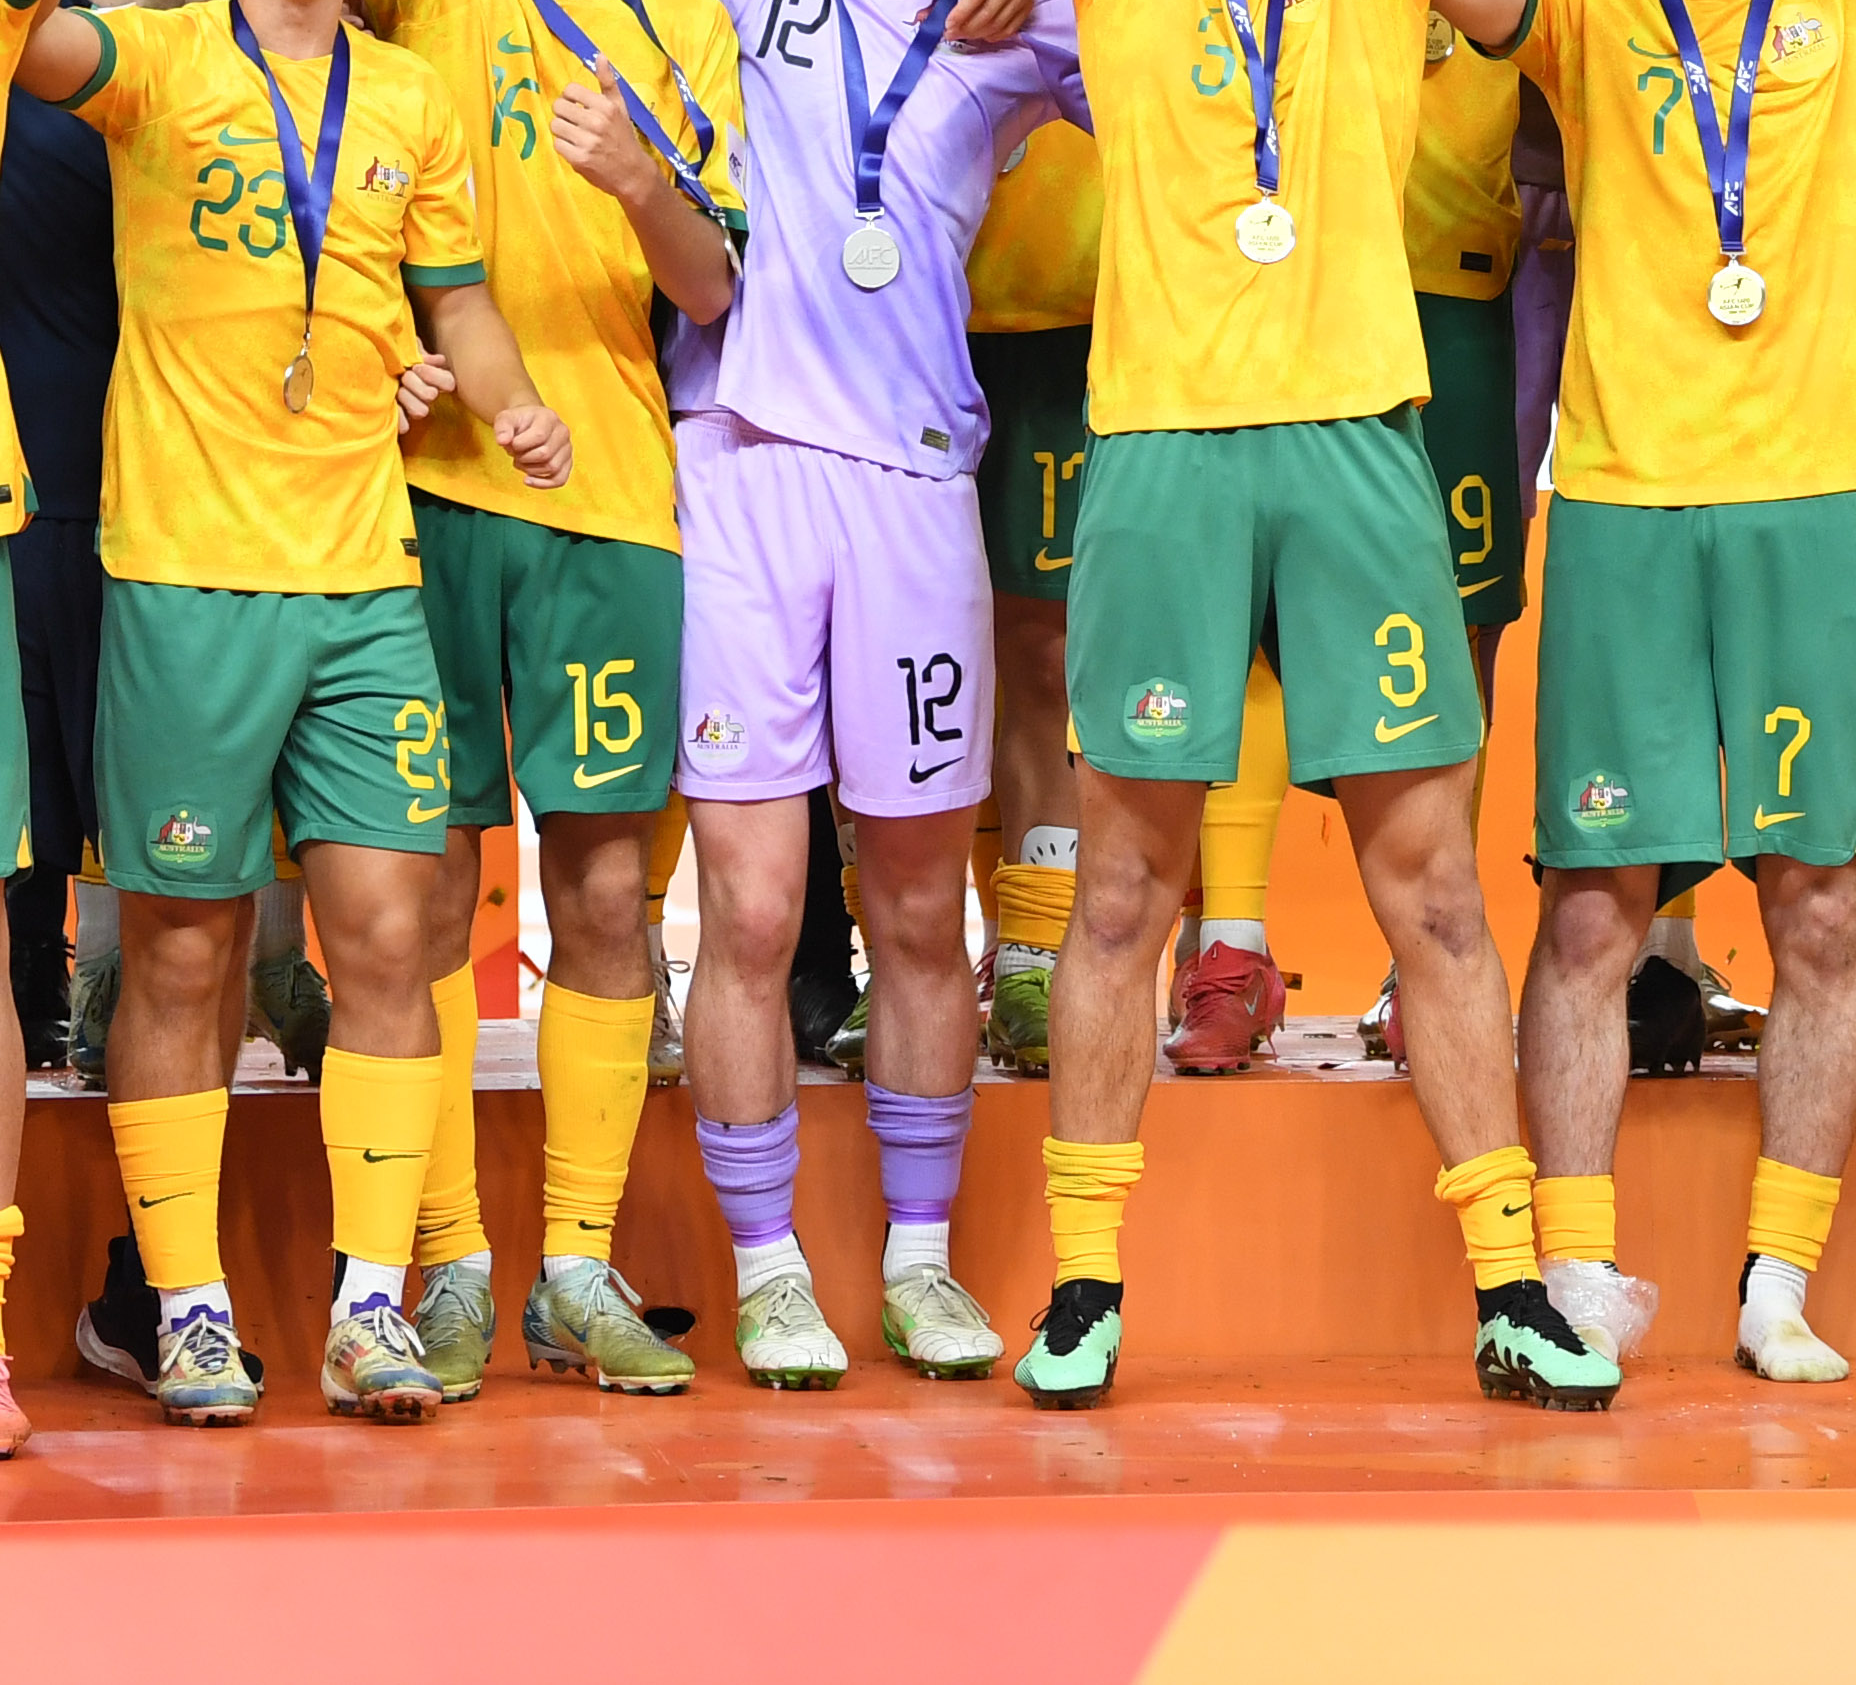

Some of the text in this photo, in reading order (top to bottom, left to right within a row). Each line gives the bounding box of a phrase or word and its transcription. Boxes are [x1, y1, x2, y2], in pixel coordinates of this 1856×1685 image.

[1190, 7, 1237, 97] 3
[1227, 0, 1252, 35] AFC
[1636, 66, 1684, 155] 7
[1686, 60, 1709, 95] AFC
[1736, 60, 1754, 94] AFC
[189, 158, 292, 259] 23
[667, 152, 698, 181] AFC
[1723, 179, 1740, 217] AFC
[846, 246, 896, 265] AFC
[1033, 451, 1084, 539] 1
[1450, 474, 1493, 565] 9
[896, 651, 963, 746] 12
[1374, 613, 1427, 708] 3
[565, 659, 643, 756] 15
[1136, 717, 1182, 727] AUSTRALIA
[1764, 705, 1811, 797] 7
[158, 843, 206, 854] AUSTRALIA
